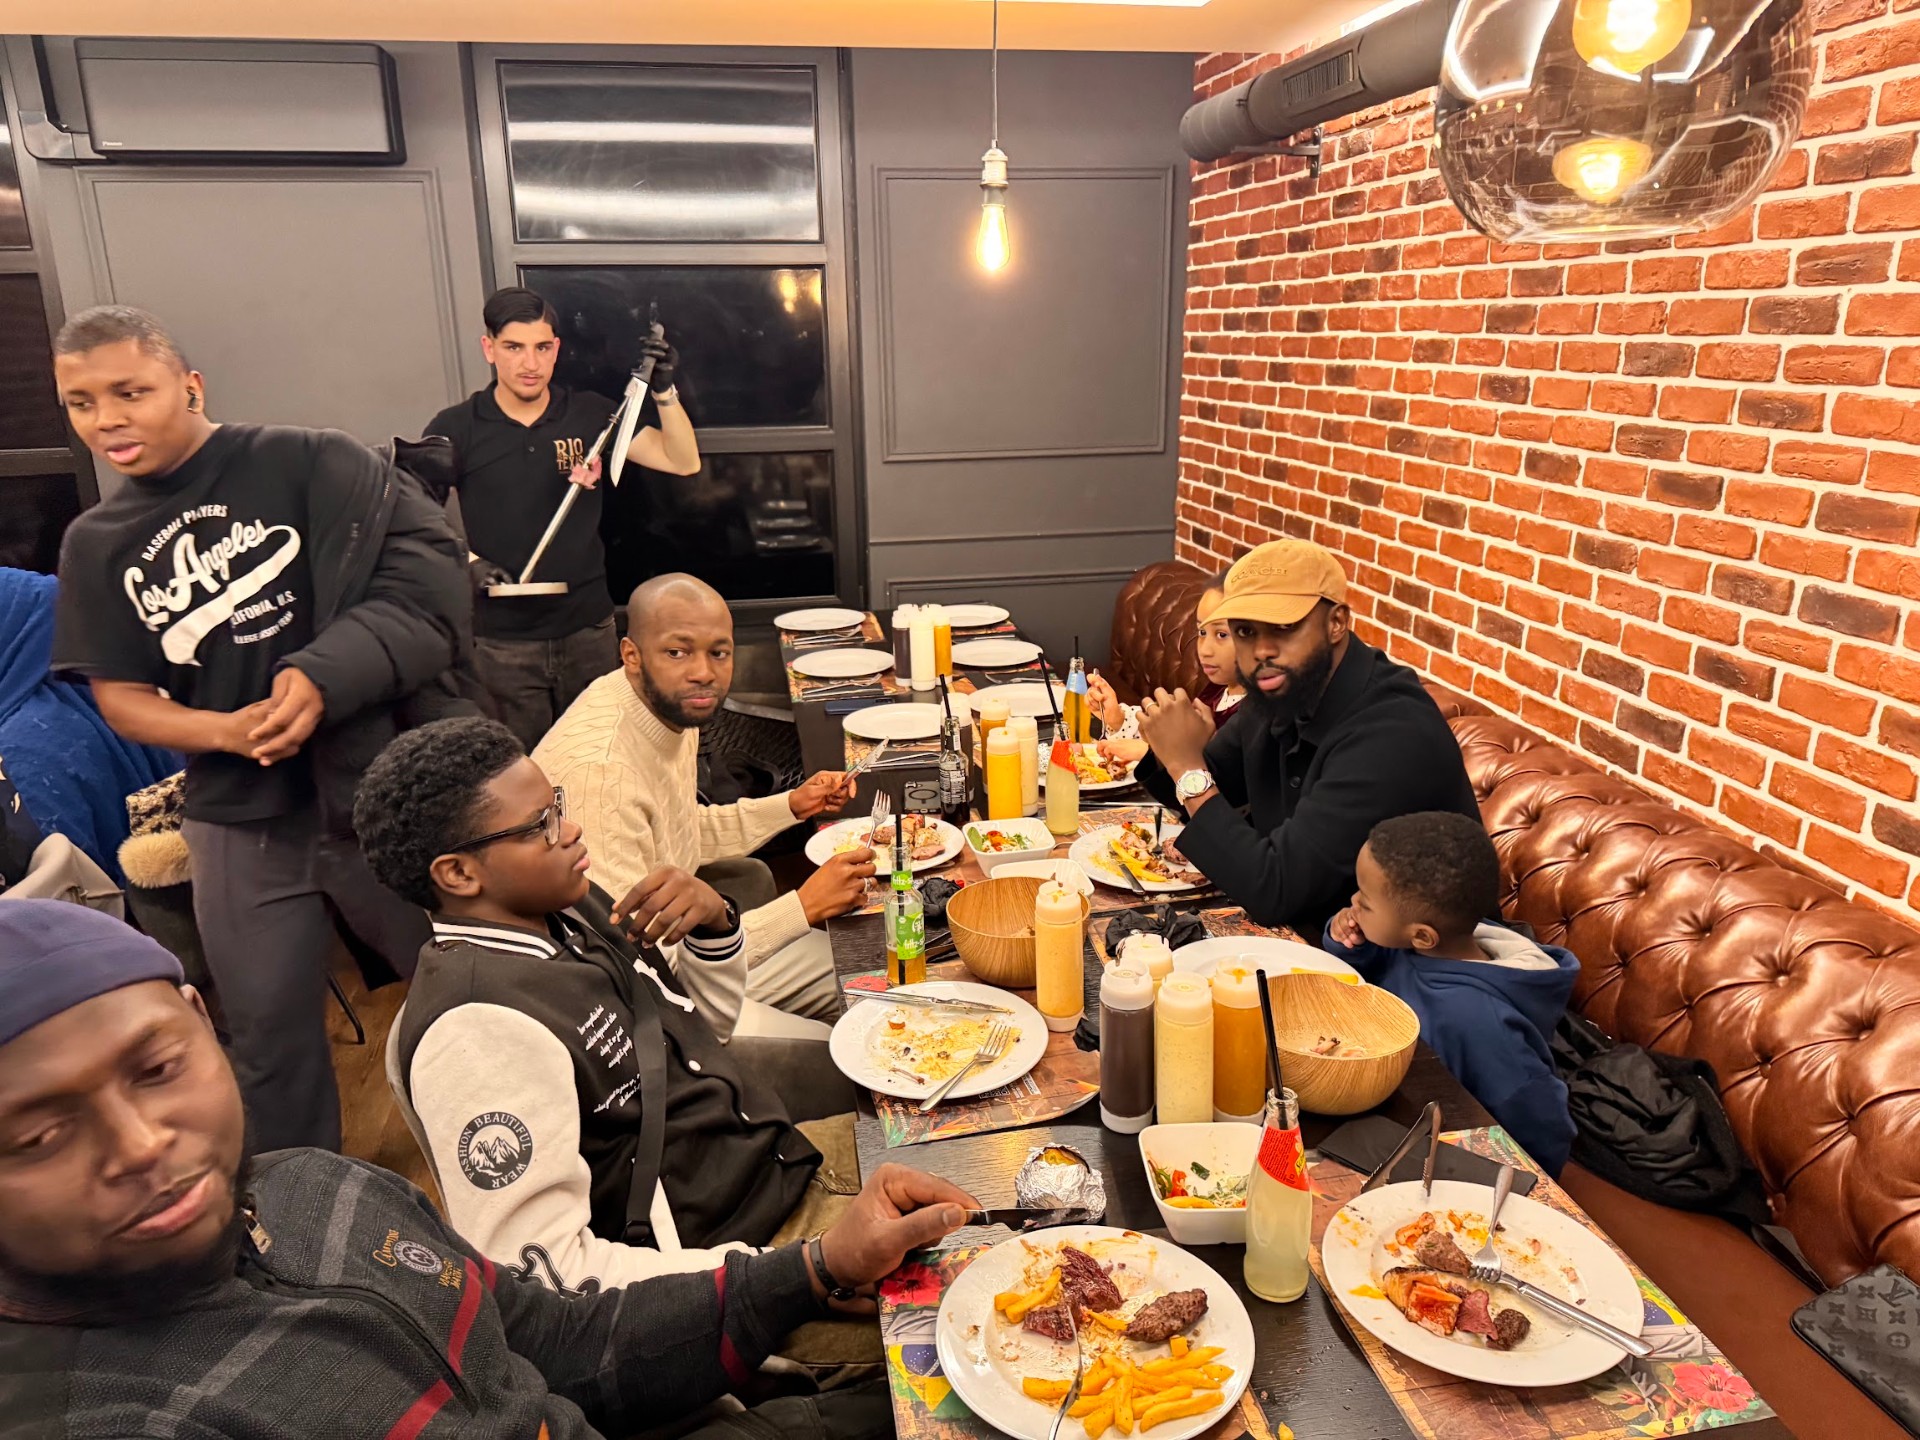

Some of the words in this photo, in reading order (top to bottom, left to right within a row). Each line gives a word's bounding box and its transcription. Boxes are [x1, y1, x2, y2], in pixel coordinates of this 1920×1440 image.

[553, 438, 583, 457] RIO
[124, 566, 170, 631] Los
[168, 518, 267, 612] Angeles
[474, 1113, 532, 1151] BEAUTIFUL
[459, 1128, 475, 1180] FASHION
[492, 1163, 527, 1188] WEAR
